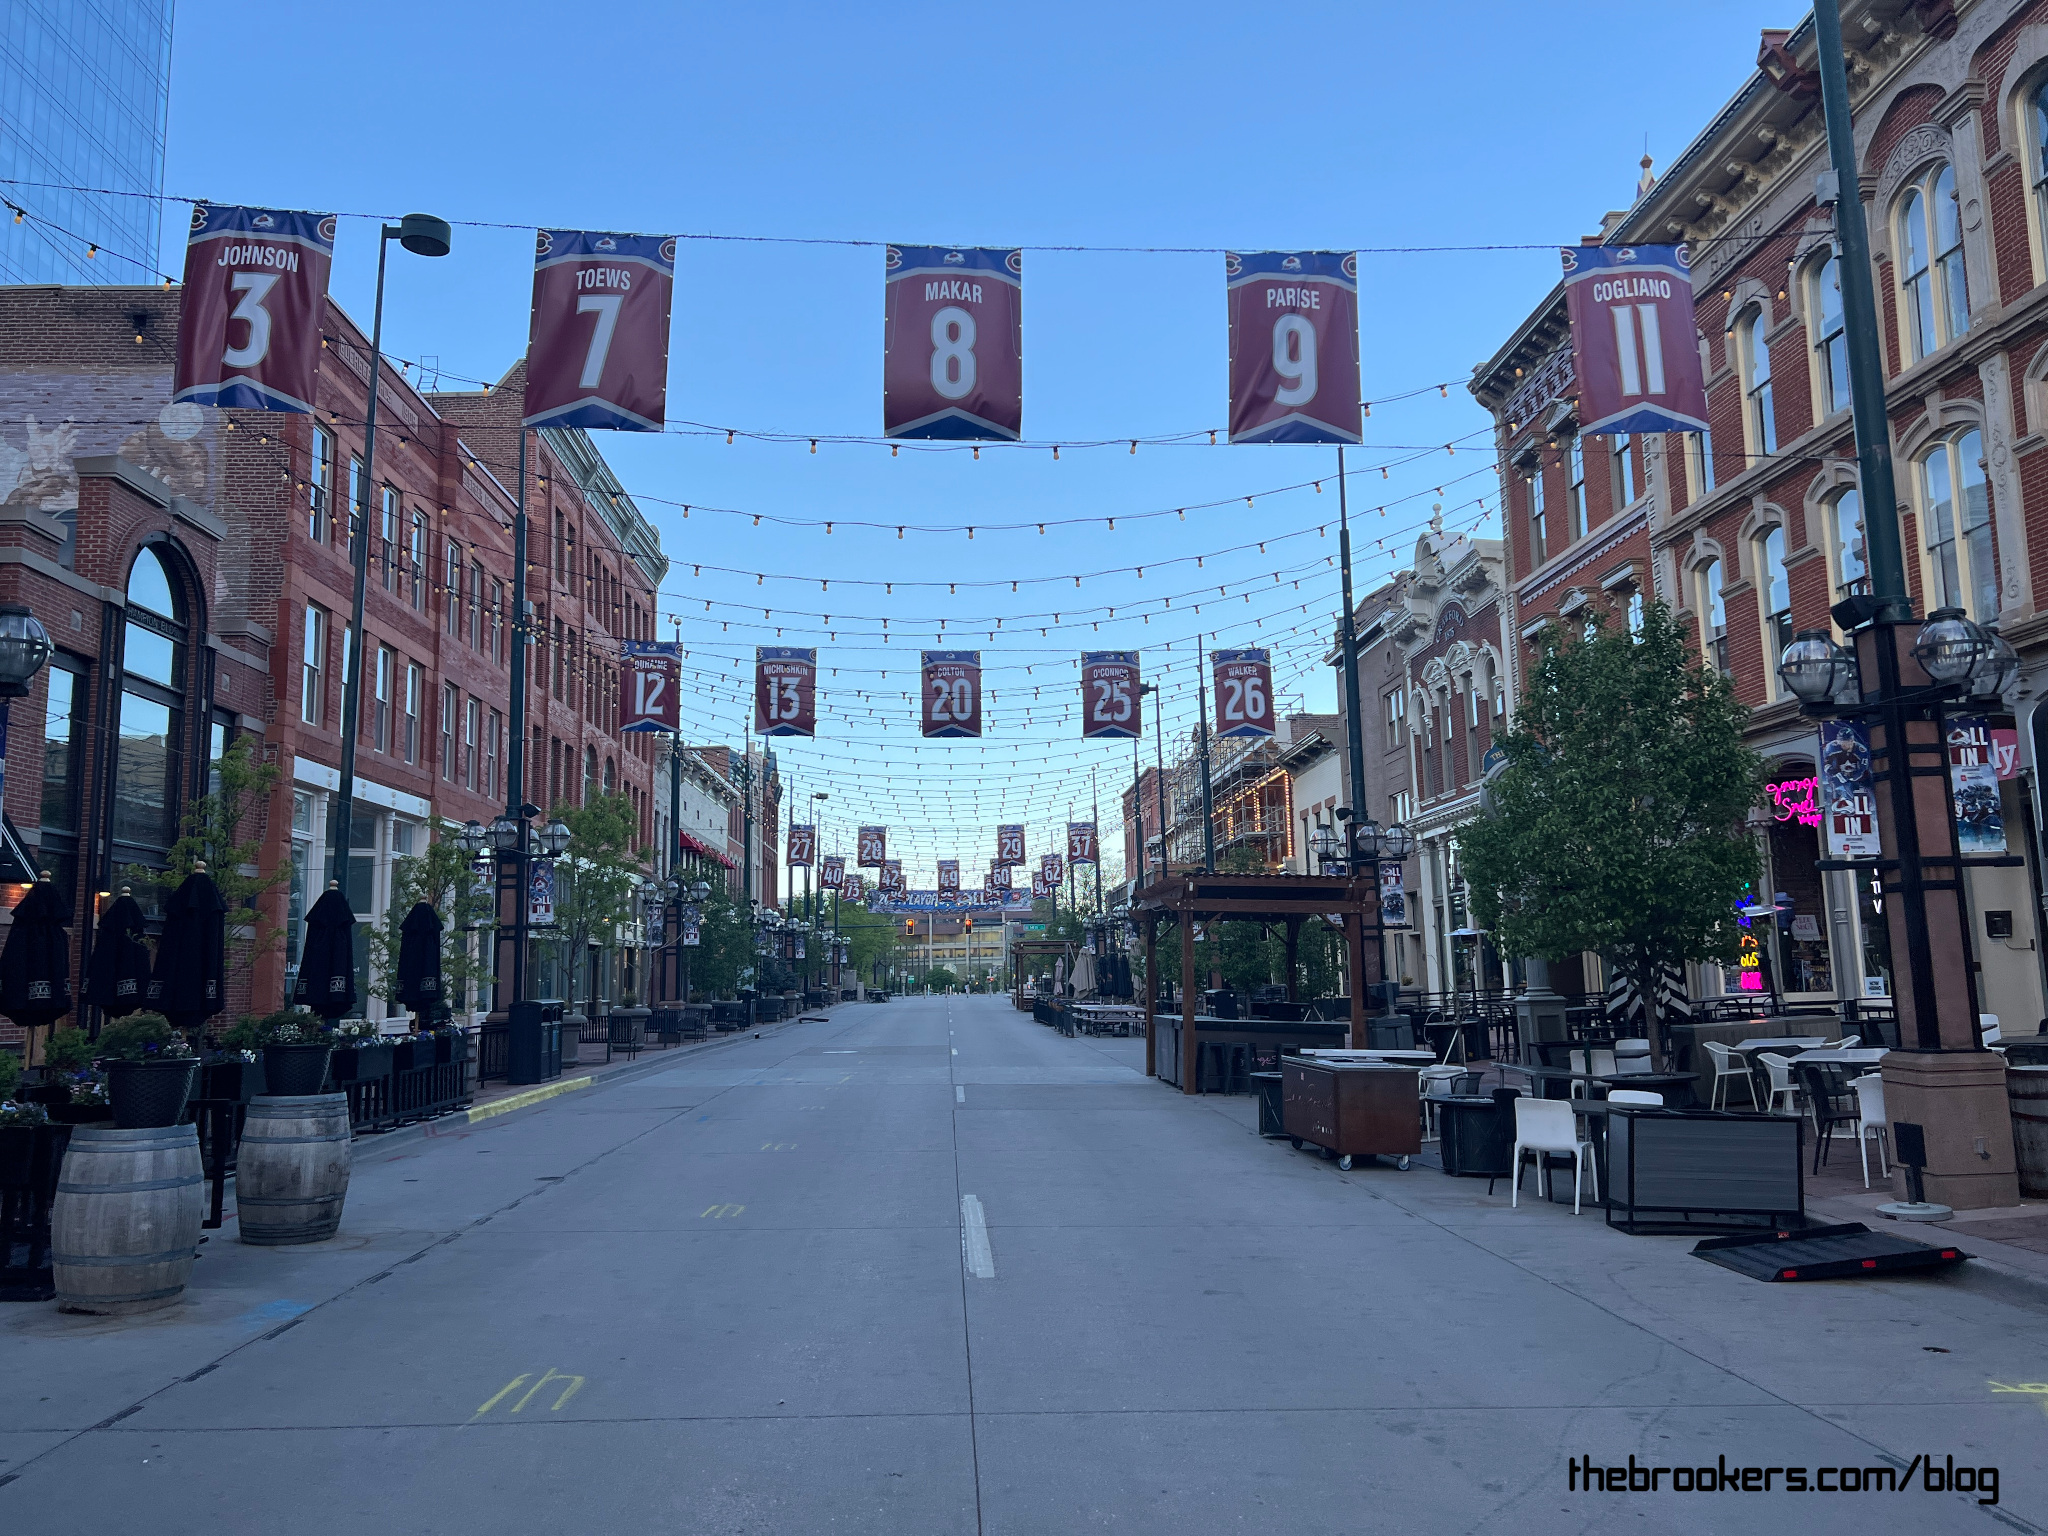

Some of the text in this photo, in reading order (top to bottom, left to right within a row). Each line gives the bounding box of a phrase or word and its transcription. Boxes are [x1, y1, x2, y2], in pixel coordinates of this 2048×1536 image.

[217, 245, 299, 273] JOHNSON
[576, 268, 632, 291] TOEWS
[1593, 277, 1672, 303] COGLIANO
[925, 281, 983, 304] MAKAR
[1266, 288, 1321, 310] PARISE
[222, 271, 281, 369] 3
[577, 294, 625, 389] 7
[930, 305, 977, 400] 8
[1610, 302, 1667, 397] 11
[1272, 313, 1319, 407] 9
[937, 667, 965, 678] COLTON
[1093, 668, 1129, 679] O'CONNOR
[1227, 665, 1258, 677] WALKER
[635, 671, 666, 716] 12
[769, 676, 801, 720] 13
[931, 678, 973, 722] 20
[1092, 679, 1132, 722] 25
[1223, 676, 1266, 721] 26
[1960, 748, 1979, 767] IN
[1844, 816, 1862, 836] IN
[791, 838, 812, 859] 27
[1002, 837, 1022, 859] 29
[1071, 835, 1091, 857] 37
[823, 867, 842, 884] 40
[881, 870, 899, 887] 42
[940, 870, 958, 887] 49
[993, 868, 1009, 885] 60
[1044, 865, 1061, 881] 62
[1387, 877, 1396, 886] IN
[537, 905, 546, 915] IN
